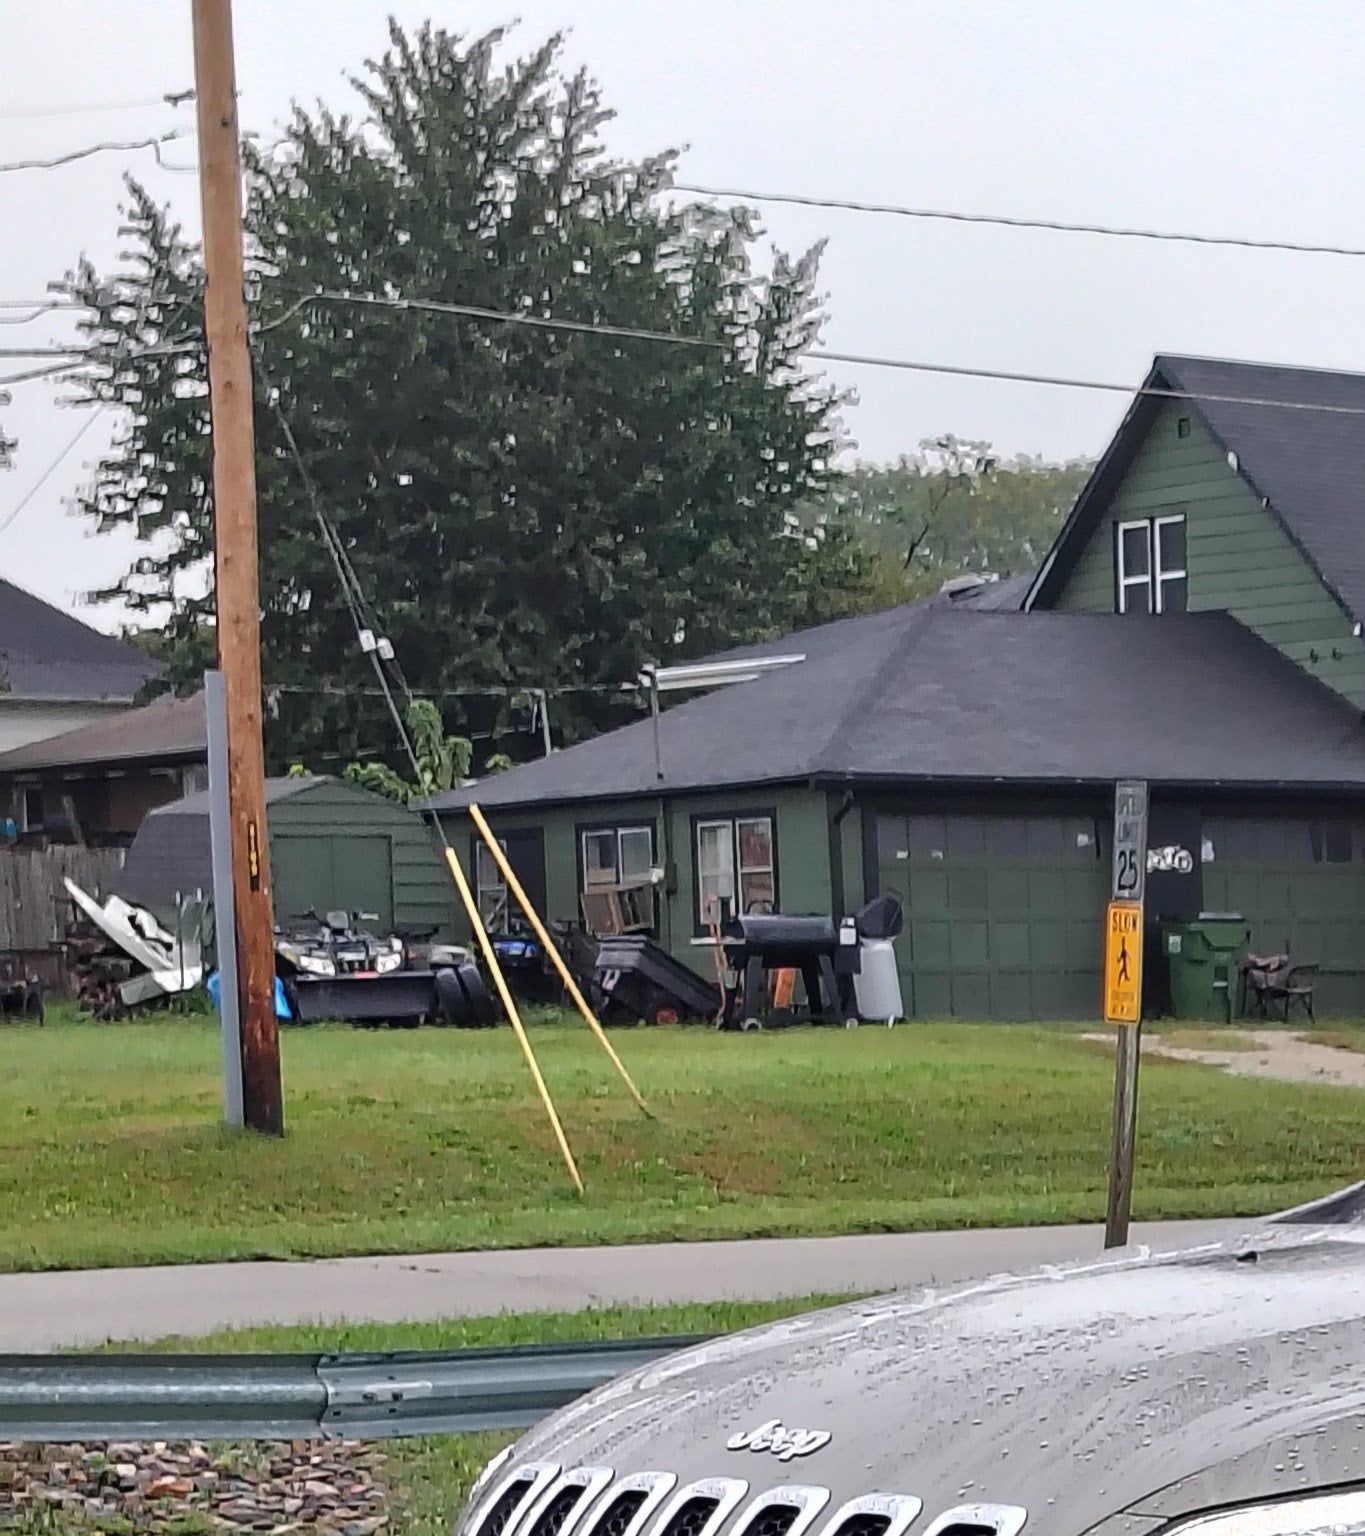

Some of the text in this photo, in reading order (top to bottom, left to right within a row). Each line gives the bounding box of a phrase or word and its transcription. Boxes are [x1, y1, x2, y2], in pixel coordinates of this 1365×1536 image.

[1118, 850, 1138, 891] 25
[1112, 911, 1137, 932] SLOW
[726, 1419, 832, 1462] Jeep
